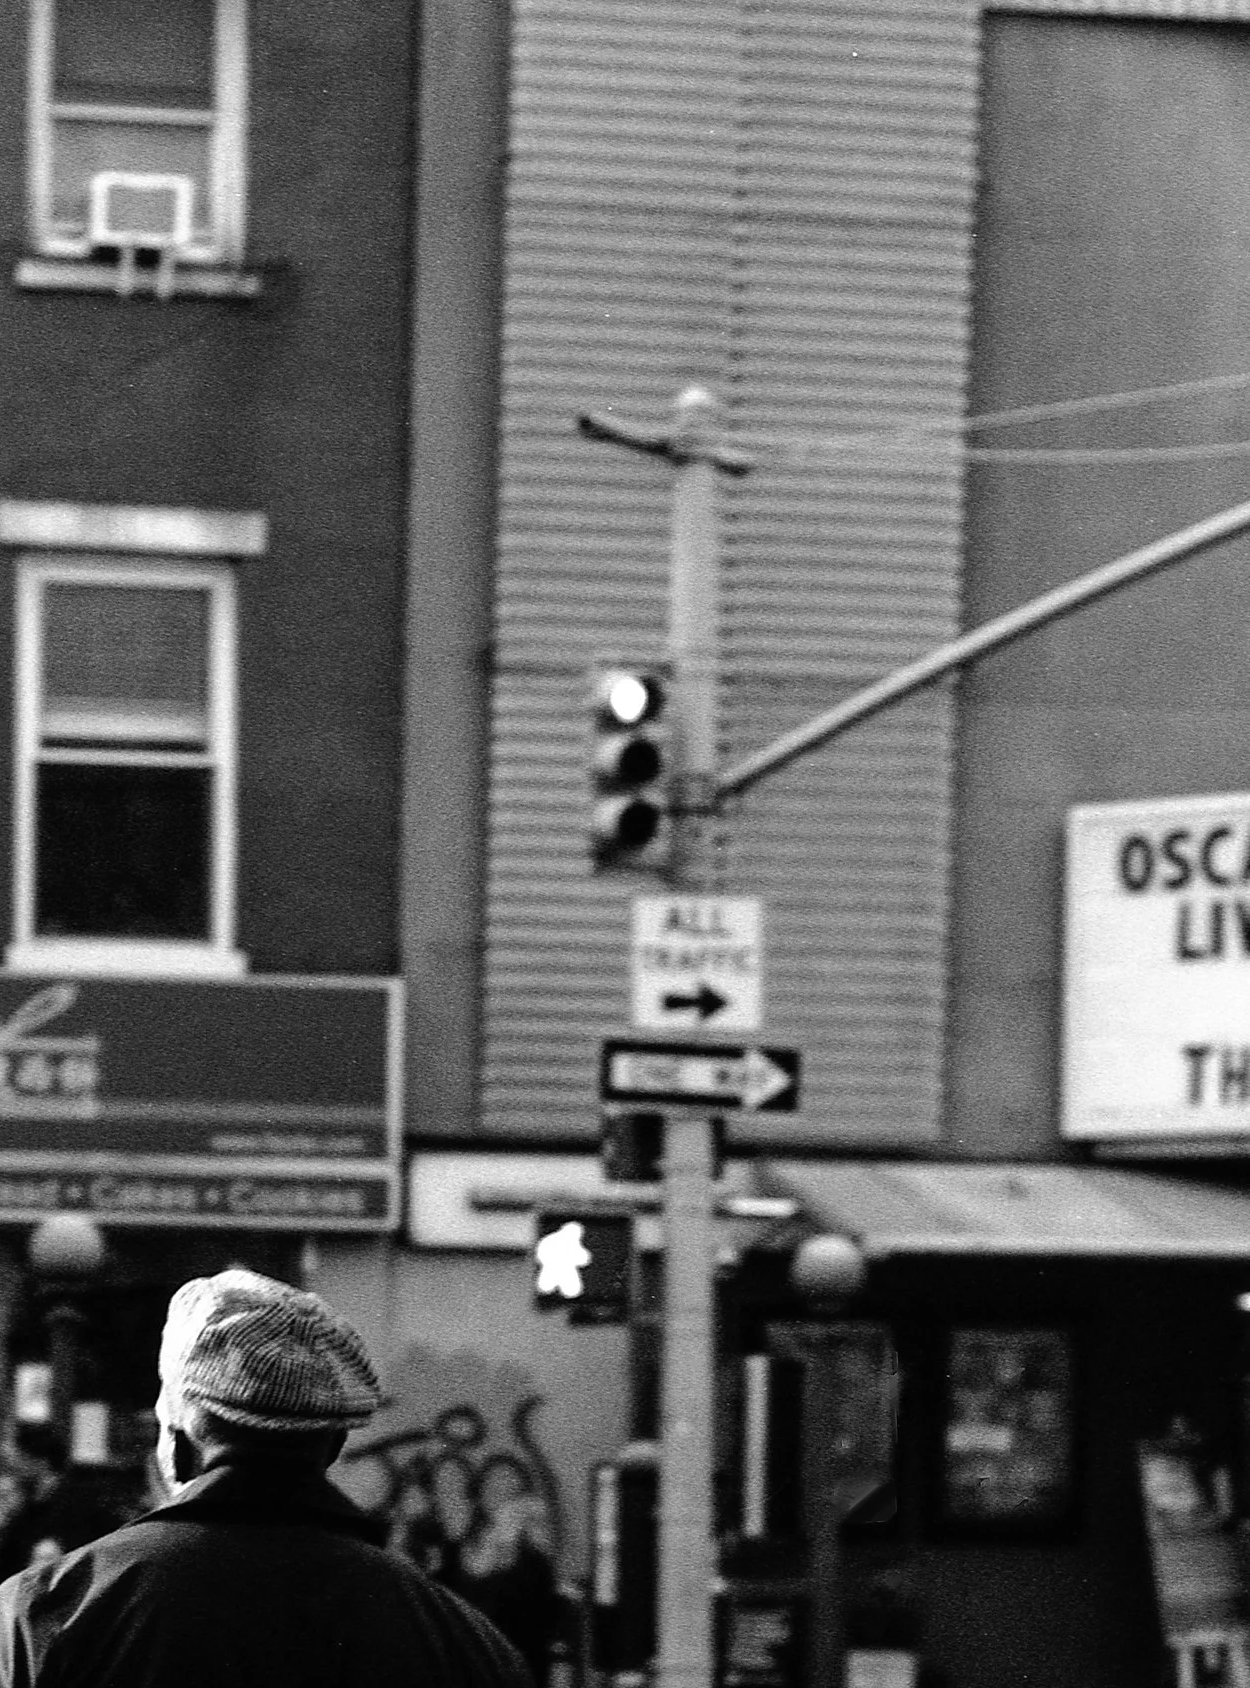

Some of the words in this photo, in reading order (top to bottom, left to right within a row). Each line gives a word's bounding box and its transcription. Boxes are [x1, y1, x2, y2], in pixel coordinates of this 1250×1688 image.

[1118, 825, 1250, 894] OSC
[661, 905, 731, 938] ALL
[642, 945, 756, 975] TRAFFIC
